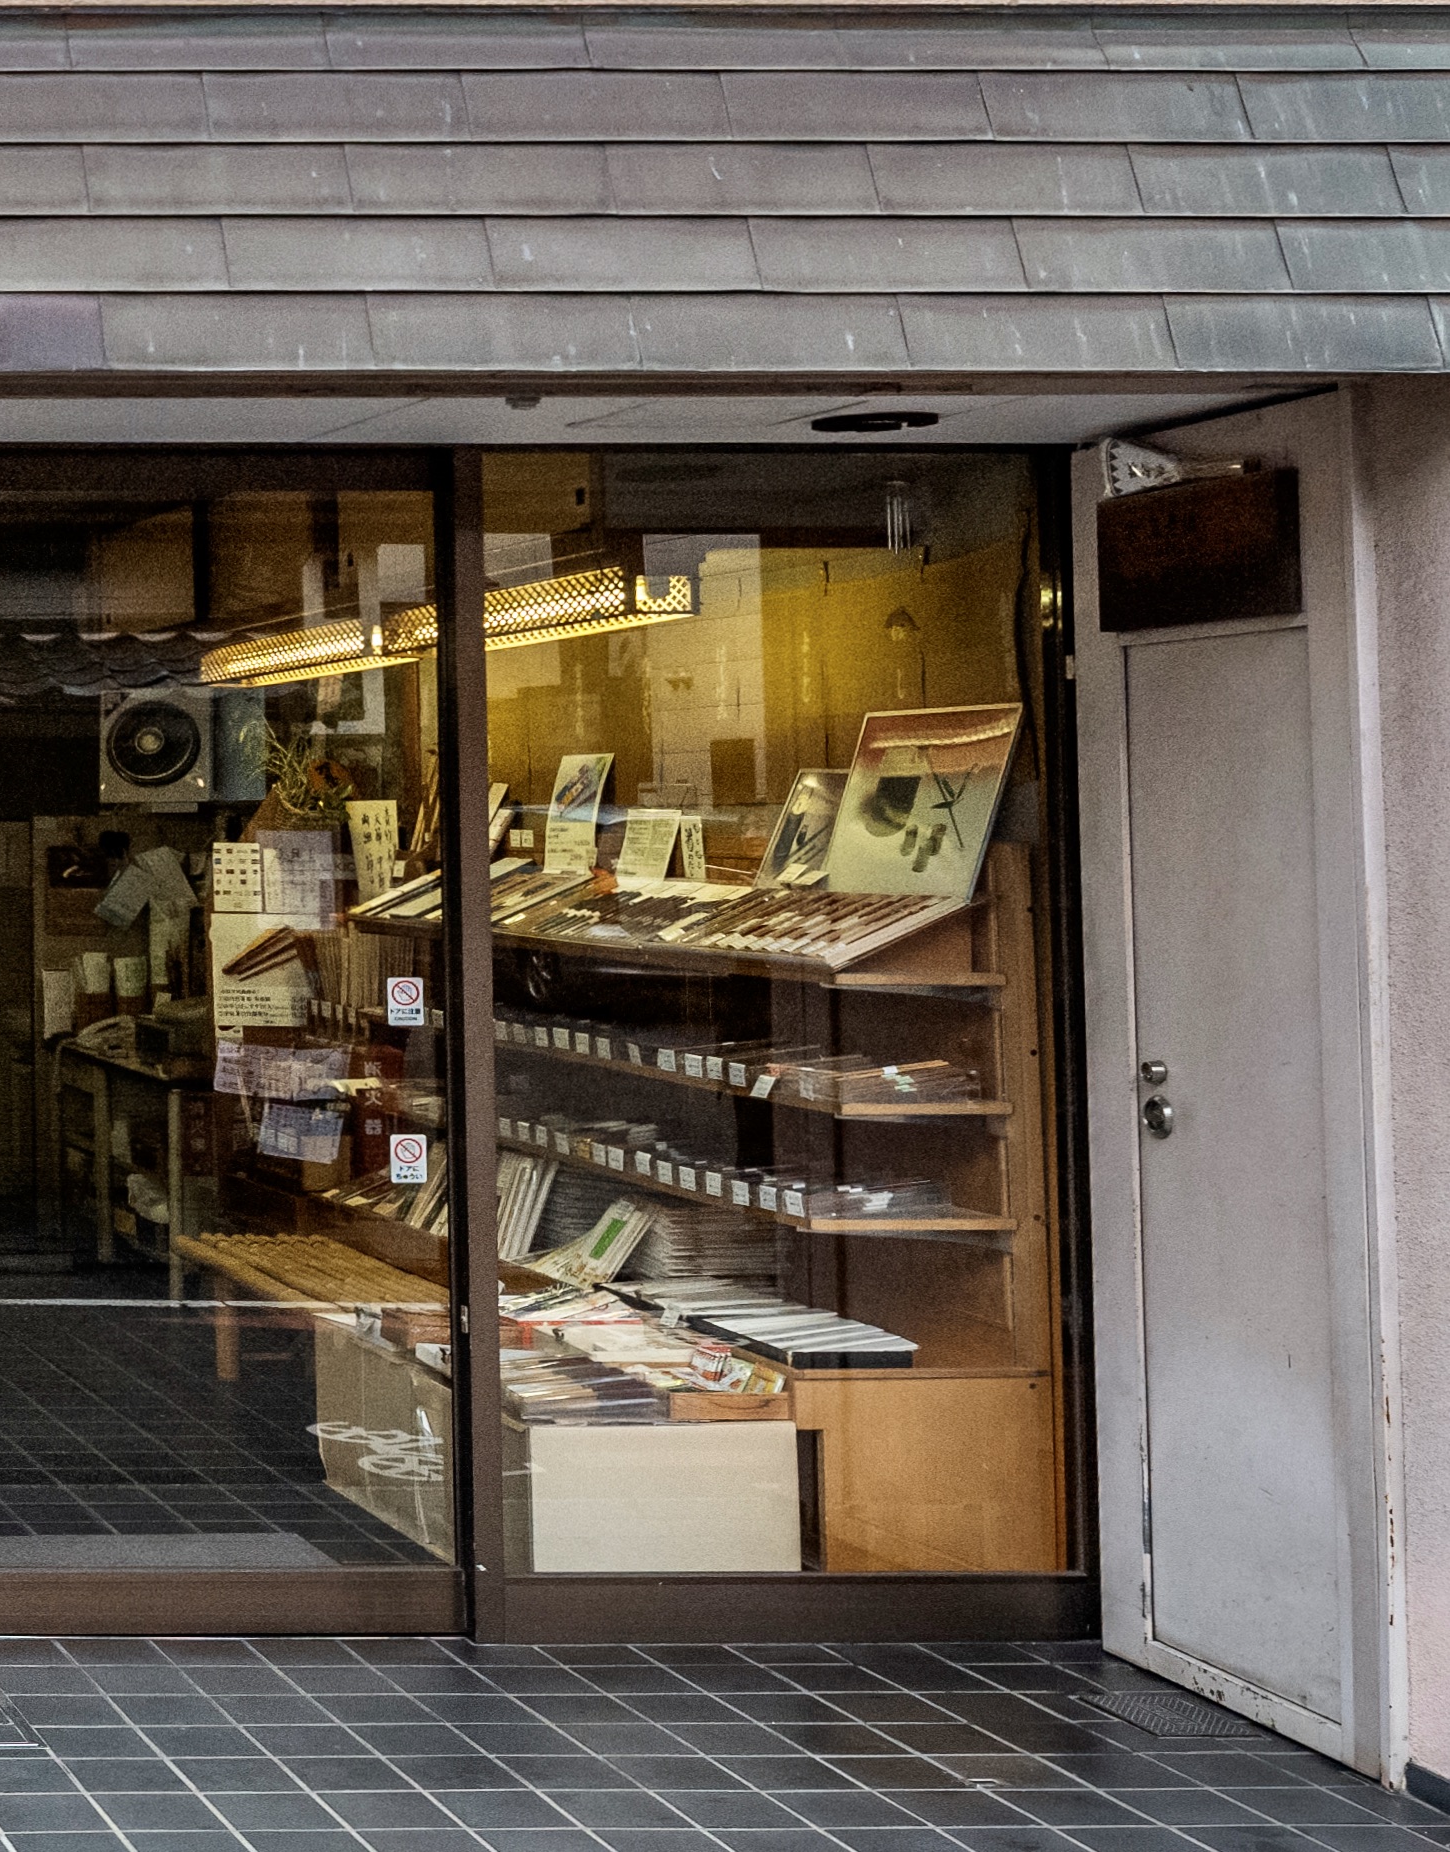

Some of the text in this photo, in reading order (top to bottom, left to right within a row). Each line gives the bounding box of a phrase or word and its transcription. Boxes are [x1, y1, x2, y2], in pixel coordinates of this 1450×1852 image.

[389, 1007, 421, 1015] ドアに注意
